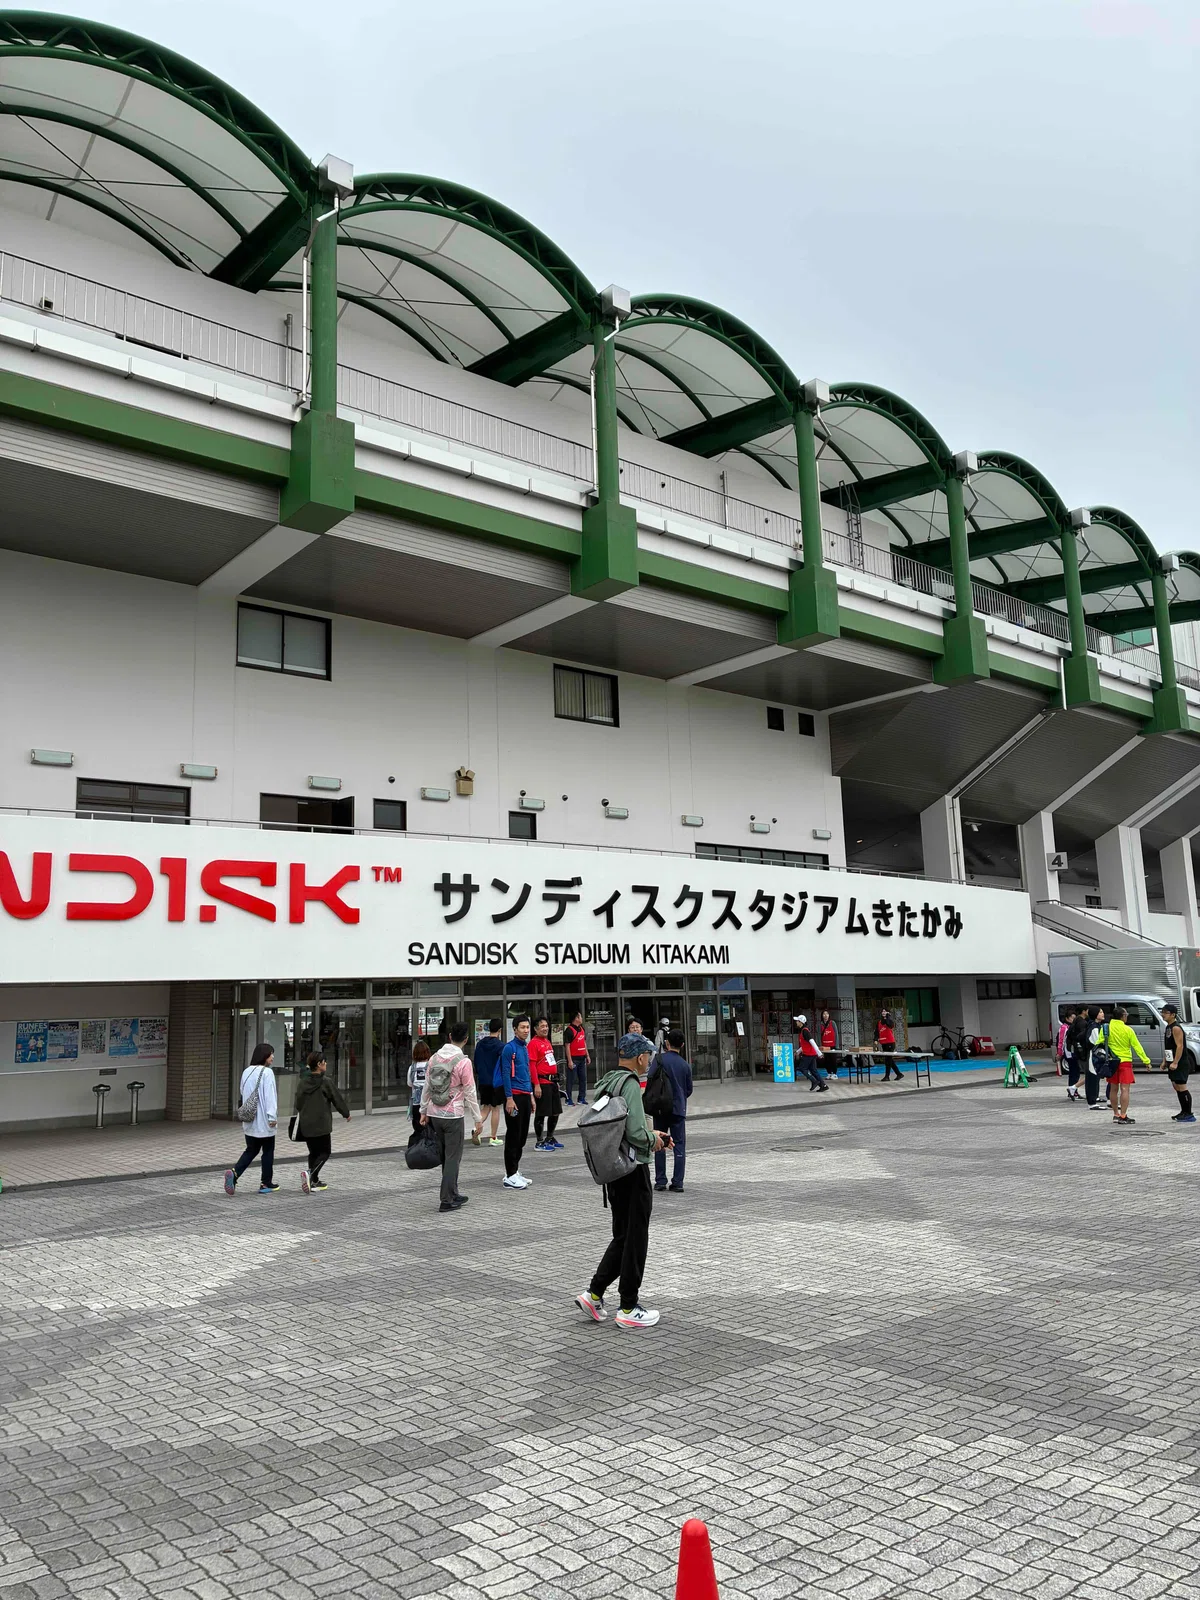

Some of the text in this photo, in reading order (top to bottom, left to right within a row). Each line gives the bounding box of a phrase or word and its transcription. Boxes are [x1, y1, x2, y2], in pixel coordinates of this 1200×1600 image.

[1051, 854, 1064, 867] 4
[433, 872, 964, 939] サンディスクスタジアムきたかみ
[408, 941, 730, 965] SANDISK STADIUM KITAKAMI
